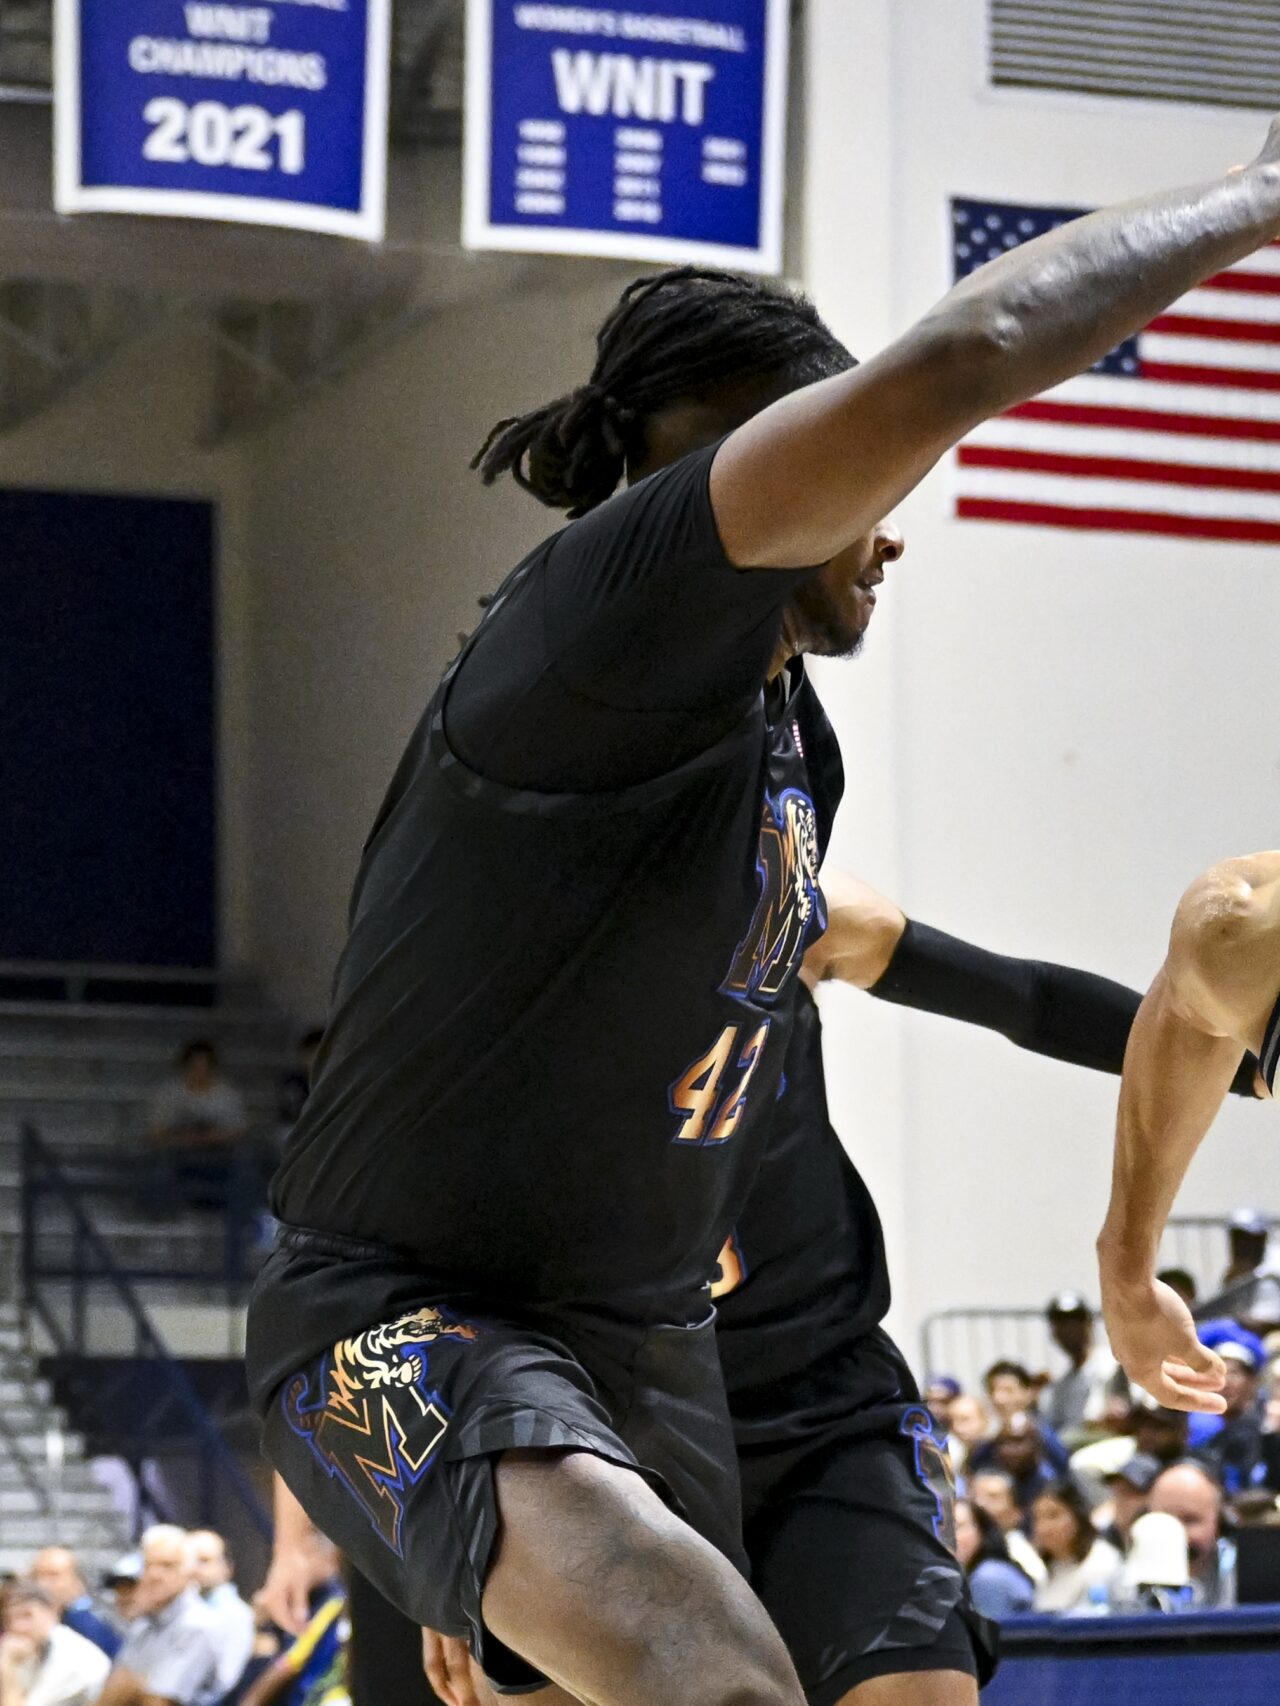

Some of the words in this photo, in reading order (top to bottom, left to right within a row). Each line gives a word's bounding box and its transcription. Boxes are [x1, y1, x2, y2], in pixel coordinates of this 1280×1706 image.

[184, 3, 273, 44] WNIT
[128, 35, 327, 91] CHAMPIONS
[552, 48, 715, 126] WNIT
[142, 96, 306, 175] 2021
